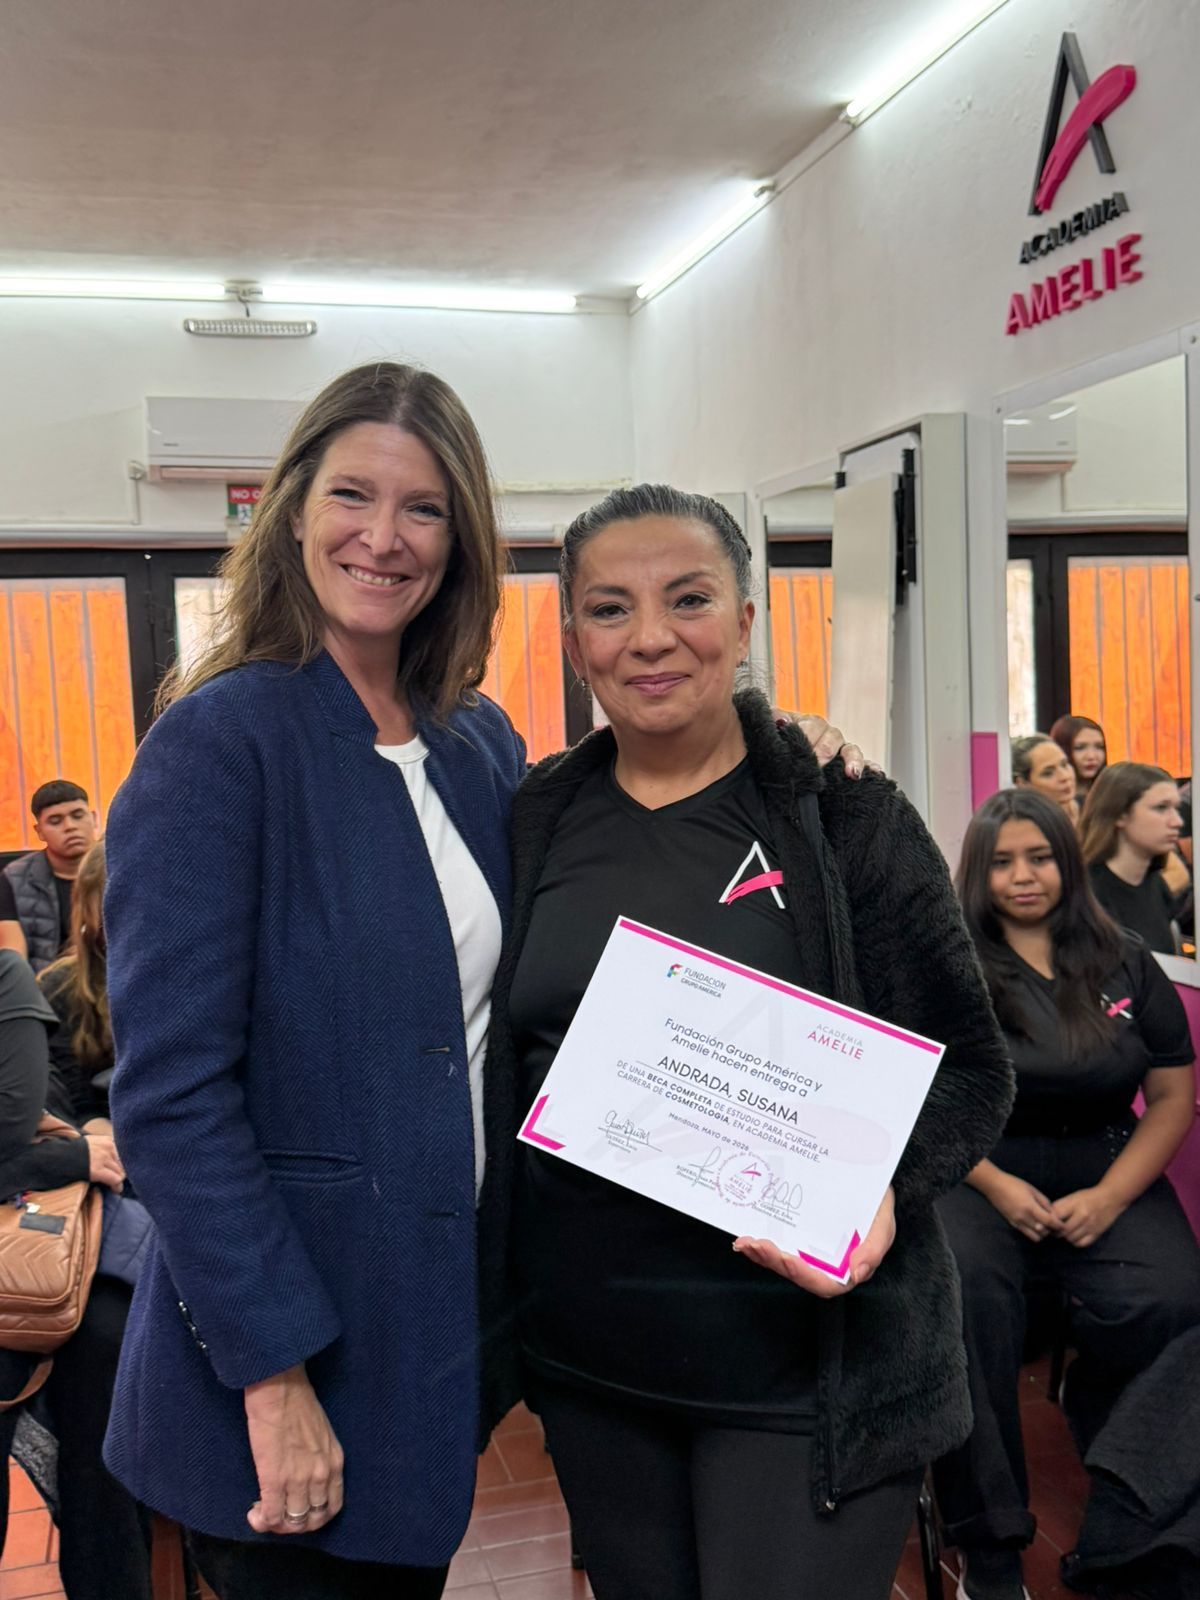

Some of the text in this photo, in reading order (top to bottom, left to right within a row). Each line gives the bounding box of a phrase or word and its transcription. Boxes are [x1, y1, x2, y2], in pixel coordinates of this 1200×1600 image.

[1020, 192, 1130, 264] ACADEMIA
[1006, 234, 1143, 335] AMELIE
[230, 488, 250, 500] NO
[664, 1017, 823, 1092] Fundación Grupo América y
[671, 1033, 808, 1097] Amelie hacen entrega a
[807, 1030, 863, 1060] AMELIE
[816, 1023, 863, 1047] ACADEMIA
[616, 1059, 829, 1156] DE UNA BECA COMPLETA DE ESTUDIO PARA CURSAR LA
[617, 1070, 820, 1163] CARRERA DE COSMETOLOGIA, EN ACADEMIA AMELIE.
[657, 1055, 798, 1125] ANDRADA, SUSANA
[701, 1126, 721, 1139] MAYO
[721, 1135, 731, 1144] de
